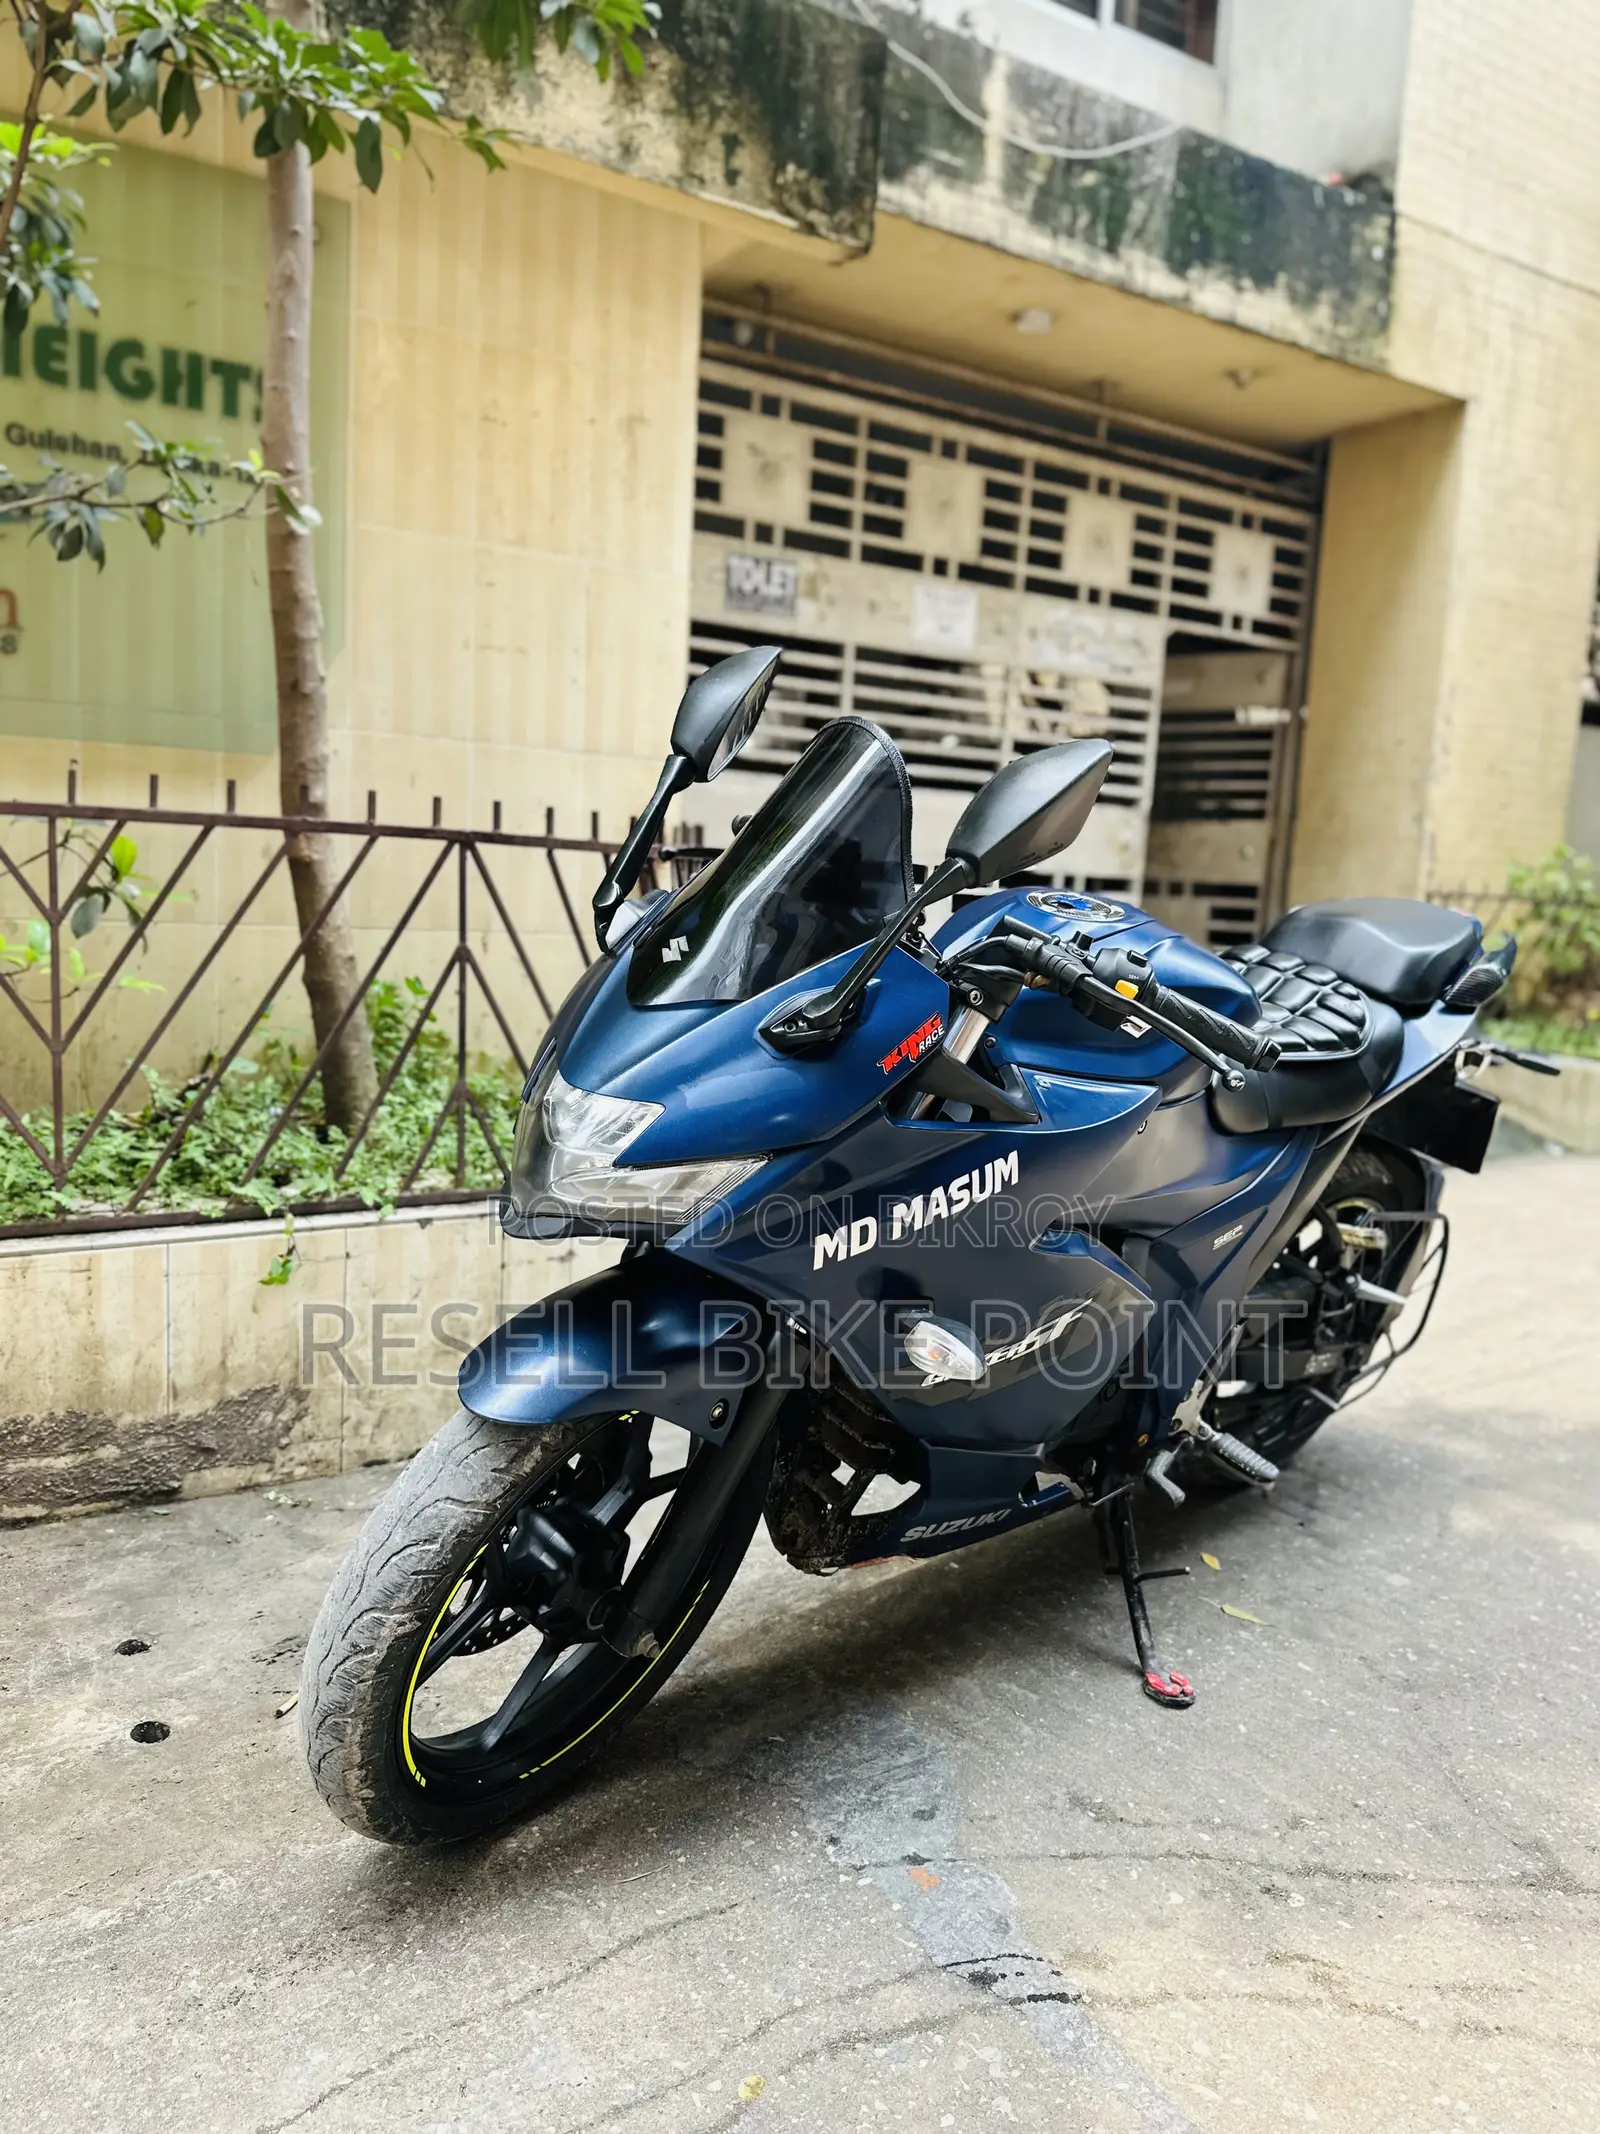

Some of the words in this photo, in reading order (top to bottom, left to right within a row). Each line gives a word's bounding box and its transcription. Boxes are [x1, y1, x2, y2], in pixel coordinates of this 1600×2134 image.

[0, 322, 263, 424] EIGHT
[919, 1024, 945, 1054] RACE
[813, 1216, 877, 1271] MD
[892, 1150, 1019, 1240] MASUM
[900, 1508, 1012, 1542] SUZUKI
